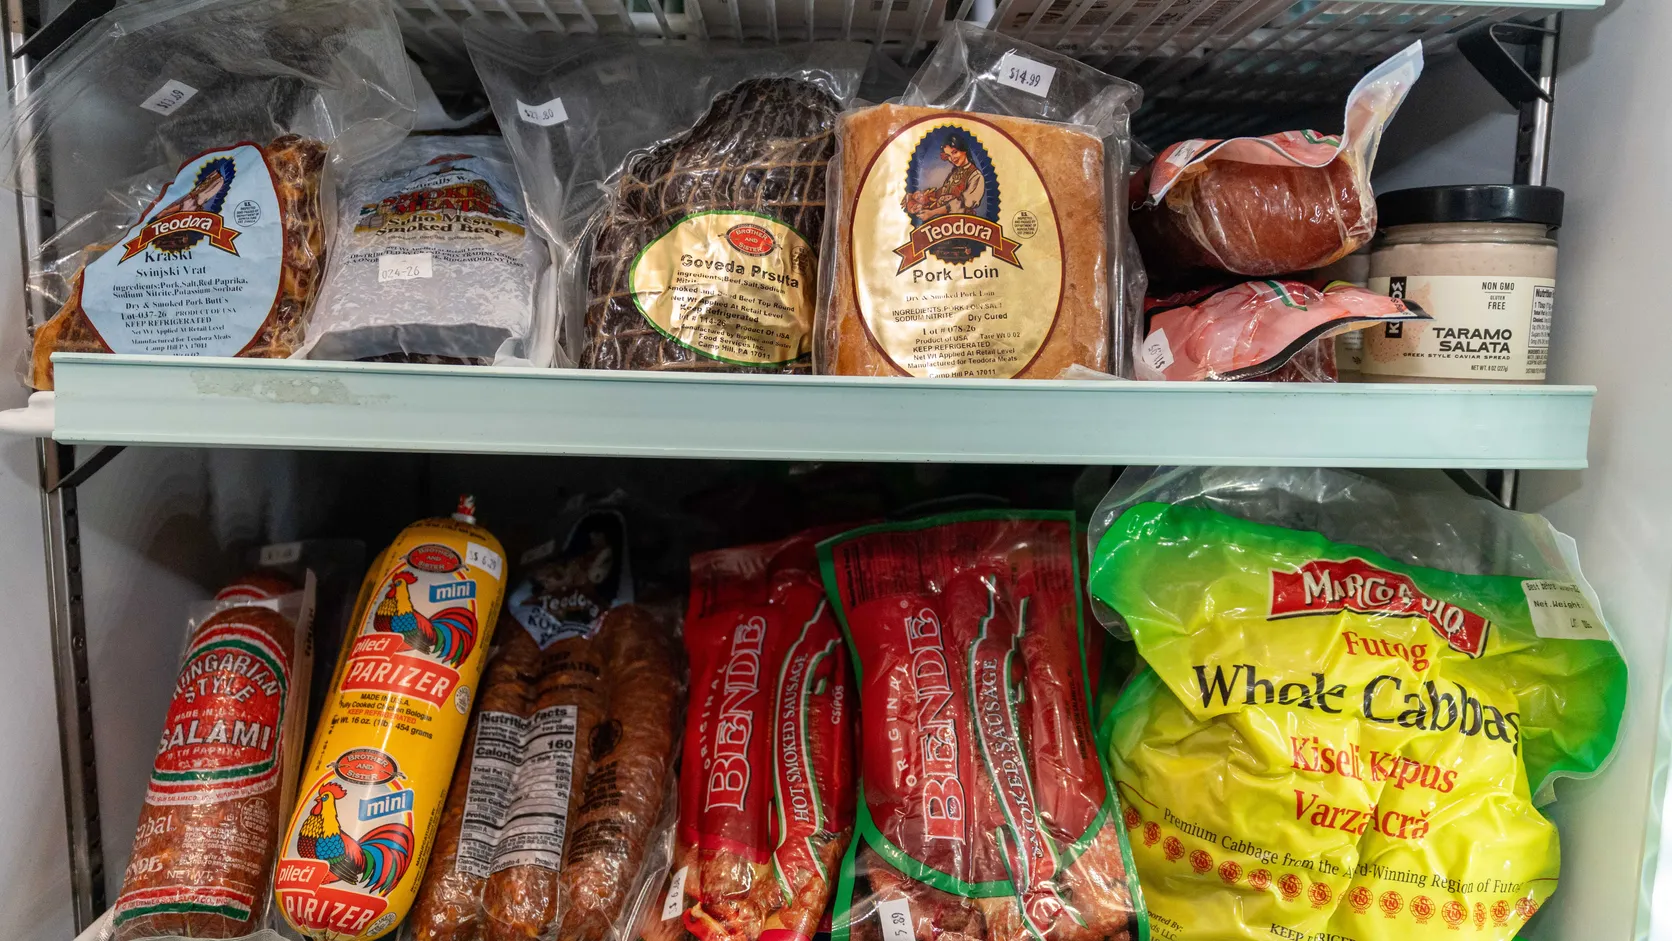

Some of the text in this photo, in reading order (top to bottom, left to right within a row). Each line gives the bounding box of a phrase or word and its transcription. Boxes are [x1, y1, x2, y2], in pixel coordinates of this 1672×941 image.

[1009, 67, 1041, 87] $14.99
[151, 215, 213, 236] Teodora
[387, 213, 493, 226] Suho Meso
[375, 222, 504, 239] Smoked Beef
[735, 228, 769, 241] BROTHER
[920, 219, 993, 243] Teodora
[738, 242, 763, 252] SISTER
[744, 236, 759, 244] AND
[136, 265, 206, 279] Svinjski Vrat
[381, 265, 420, 279] 024-26
[680, 253, 799, 289] Goveda Prsuta
[912, 265, 999, 283] Pork Loin
[1481, 282, 1516, 291] NON GMO
[113, 291, 144, 299] Sodium
[125, 298, 203, 310] Dry & Smoked Pork
[739, 294, 756, 304] Beef
[757, 299, 772, 308] Top
[773, 302, 795, 312] Round
[1487, 301, 1507, 310] FREE
[175, 309, 209, 317] PRODUCT
[706, 307, 759, 323] Refrigerated
[740, 305, 784, 319] Retail Level
[894, 312, 954, 323] SODIUM NITRITE
[967, 312, 1008, 322] Dry Cured
[125, 317, 212, 328] KEEP REFRIGERATED
[699, 314, 727, 327] 114-26
[735, 323, 764, 335] Product
[1432, 327, 1512, 341] TARAMO
[699, 333, 751, 348] Food Services
[912, 341, 991, 353] KEEP REFRIGERATED
[915, 337, 943, 345] Product
[1439, 340, 1511, 354] SALATA
[697, 341, 720, 350] Camp
[750, 350, 771, 360] 17011
[939, 351, 965, 360] Applied
[976, 348, 996, 356] Retail
[996, 347, 1015, 355] Level
[907, 359, 956, 369] Manufactured
[976, 368, 996, 376] 17011
[436, 582, 470, 600] mini
[1302, 567, 1396, 609] MARCO
[1526, 582, 1540, 592] Best
[352, 638, 391, 656] pileći
[1342, 631, 1429, 673] Futog
[173, 653, 278, 701] HUNGARIAN
[347, 661, 450, 698] PARIZER
[185, 676, 255, 703] STYLE
[1191, 663, 1348, 714] Whole
[360, 693, 380, 701] MADE
[175, 709, 199, 722] MADE
[351, 701, 376, 709] Cooked
[405, 708, 433, 722] Bologna
[364, 709, 417, 724] REFRIGERATED
[700, 664, 727, 770] ORIGINAL
[704, 615, 766, 813] BENDE
[395, 722, 409, 732] 454
[410, 727, 433, 740] grams
[887, 662, 918, 787] ORIGINAL
[904, 607, 966, 845] BENDE
[159, 719, 272, 755] SALAMI
[547, 739, 573, 750] 160
[782, 652, 810, 822] HOT SMOKED SAUSAGE
[347, 754, 389, 768] BROTHER
[475, 747, 522, 763] Calories
[982, 658, 1044, 859] SMOKED SAUSAGE
[1290, 736, 1363, 781] Kiseli
[346, 769, 378, 780] SISTER
[355, 763, 374, 771] AND
[366, 793, 406, 817] mini
[1164, 807, 1218, 844] Premium
[1221, 835, 1279, 866] Cabbage
[1282, 852, 1315, 871] from
[1318, 859, 1340, 876] the
[1431, 873, 1474, 895] Region
[1476, 878, 1491, 893] of
[167, 869, 190, 880] NET
[278, 864, 316, 885] pileći
[1171, 921, 1184, 933] By:
[1269, 922, 1305, 941] KEEP
